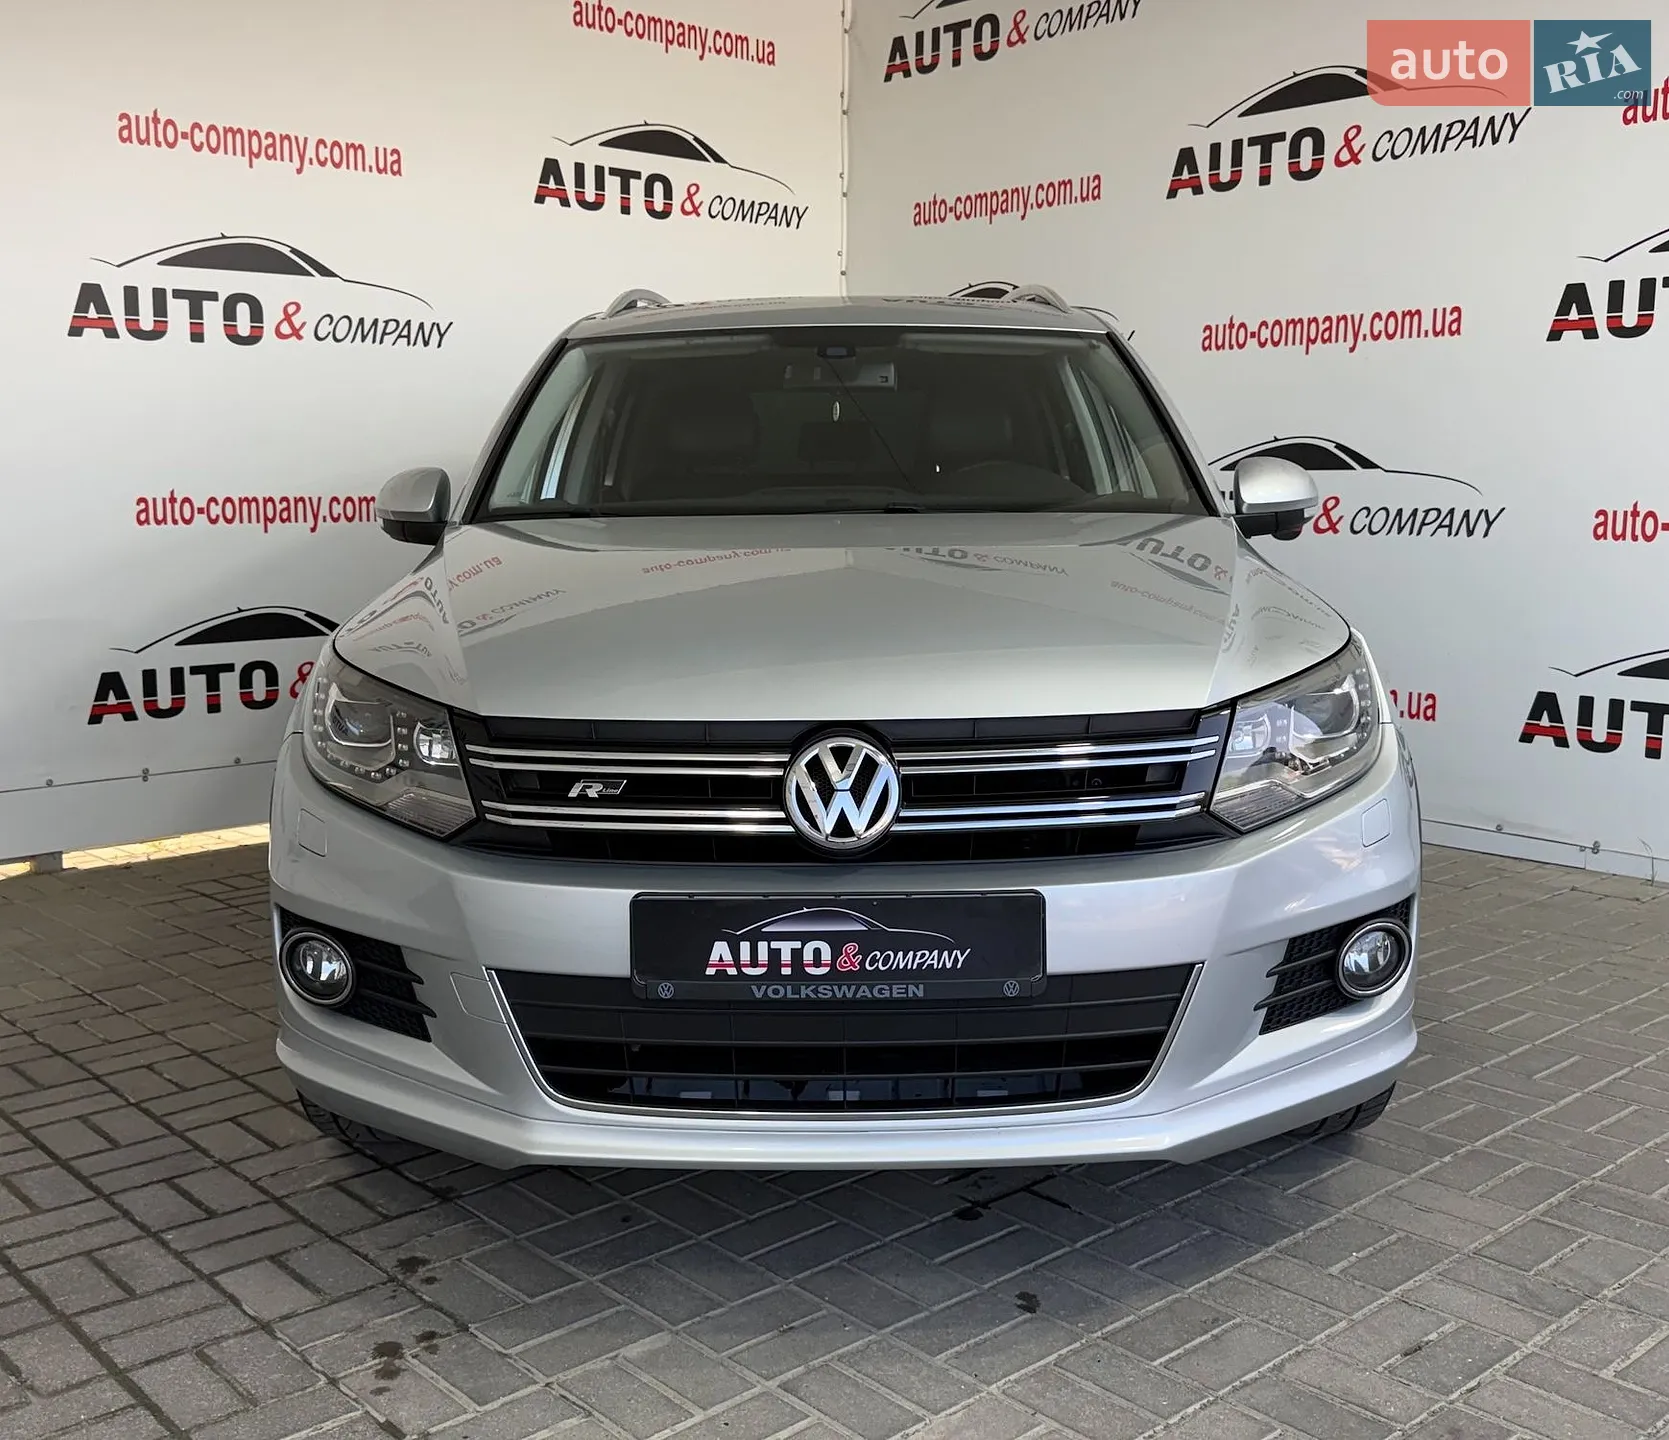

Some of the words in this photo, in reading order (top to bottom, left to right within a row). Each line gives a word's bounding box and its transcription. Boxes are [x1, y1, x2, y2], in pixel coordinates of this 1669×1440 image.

[572, 0, 776, 67] auto-company.com.ua
[883, 12, 1001, 83] AUTO
[1006, 8, 1031, 49] &
[1033, 0, 1142, 42] COMPANY
[117, 108, 403, 178] auto-company.com.ua
[1166, 126, 1326, 200] AUTO
[1332, 123, 1367, 170] &
[1371, 106, 1532, 163] COMPANY
[534, 156, 674, 221] AUTO
[679, 182, 704, 219] &
[707, 194, 809, 230] COMPANY
[912, 171, 1103, 228] auto-company.com.ua
[67, 281, 264, 346] AUTO
[273, 300, 307, 343] &
[313, 313, 454, 350] COMPANY
[1200, 301, 1463, 356] auto-company.com.ua
[1546, 276, 1669, 342] AU
[1312, 495, 1344, 536] &
[1349, 505, 1507, 540] COMPANY
[87, 659, 280, 726] AUTO
[704, 940, 832, 976] AUTO
[836, 942, 862, 971] &
[864, 948, 971, 971] COMPANY
[750, 984, 925, 999] VOLKSWAGEN
